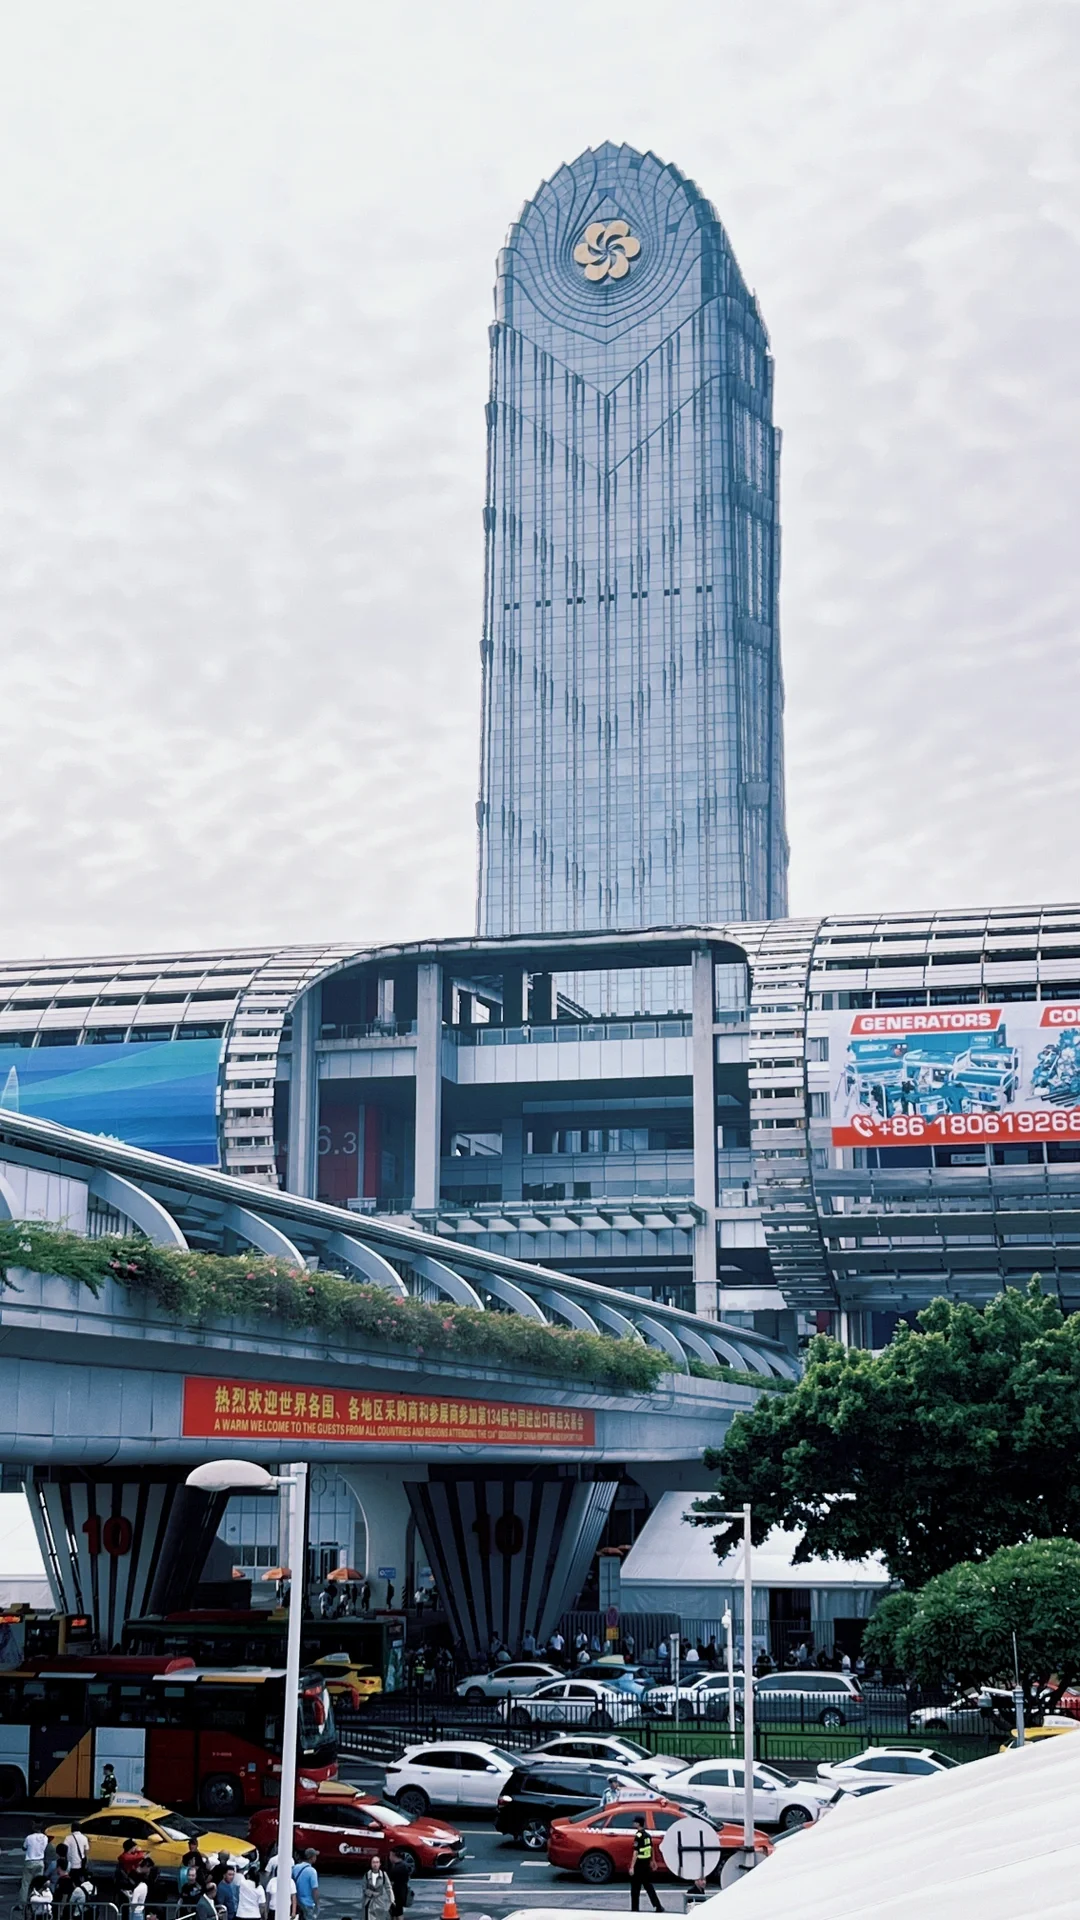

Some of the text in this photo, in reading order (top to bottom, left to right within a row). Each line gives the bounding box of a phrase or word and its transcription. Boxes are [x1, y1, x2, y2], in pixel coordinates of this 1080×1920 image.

[860, 1012, 991, 1031] GENERATORS
[1049, 1008, 1080, 1024] CO
[879, 1111, 1080, 1136] +86 180619268
[318, 1125, 357, 1155] 6.3
[214, 1418, 221, 1431] A
[222, 1419, 248, 1431] WARM
[250, 1419, 289, 1433] WELCOME
[291, 1421, 301, 1433] TO
[303, 1422, 316, 1434] THE
[318, 1423, 344, 1435] GUESTS
[346, 1424, 364, 1436] FROM
[365, 1425, 376, 1436] ALL
[82, 1515, 132, 1556] 10
[472, 1513, 524, 1555] 10
